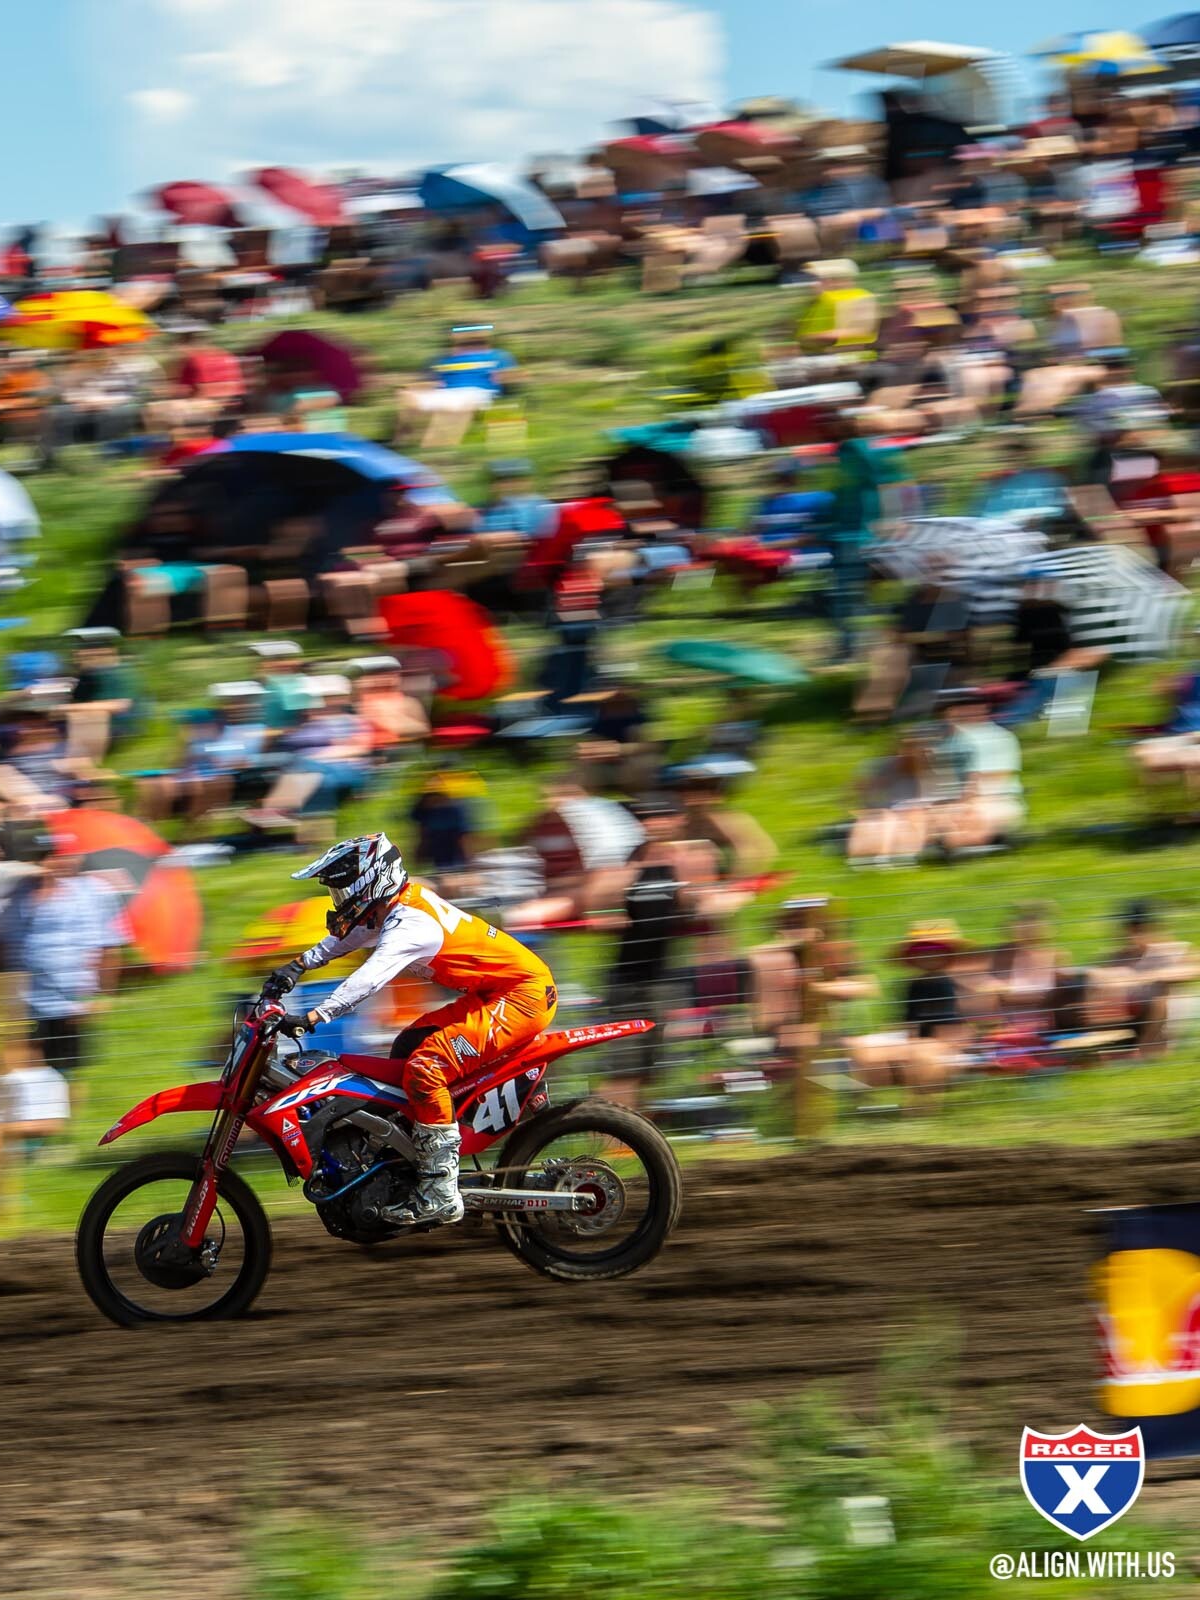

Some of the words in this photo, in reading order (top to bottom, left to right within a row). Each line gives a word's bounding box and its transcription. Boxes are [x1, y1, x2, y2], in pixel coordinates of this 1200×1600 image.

[349, 856, 387, 897] 100%
[568, 1029, 622, 1043] DUNLOP
[264, 1072, 356, 1115] CRF
[472, 1078, 521, 1134] 41
